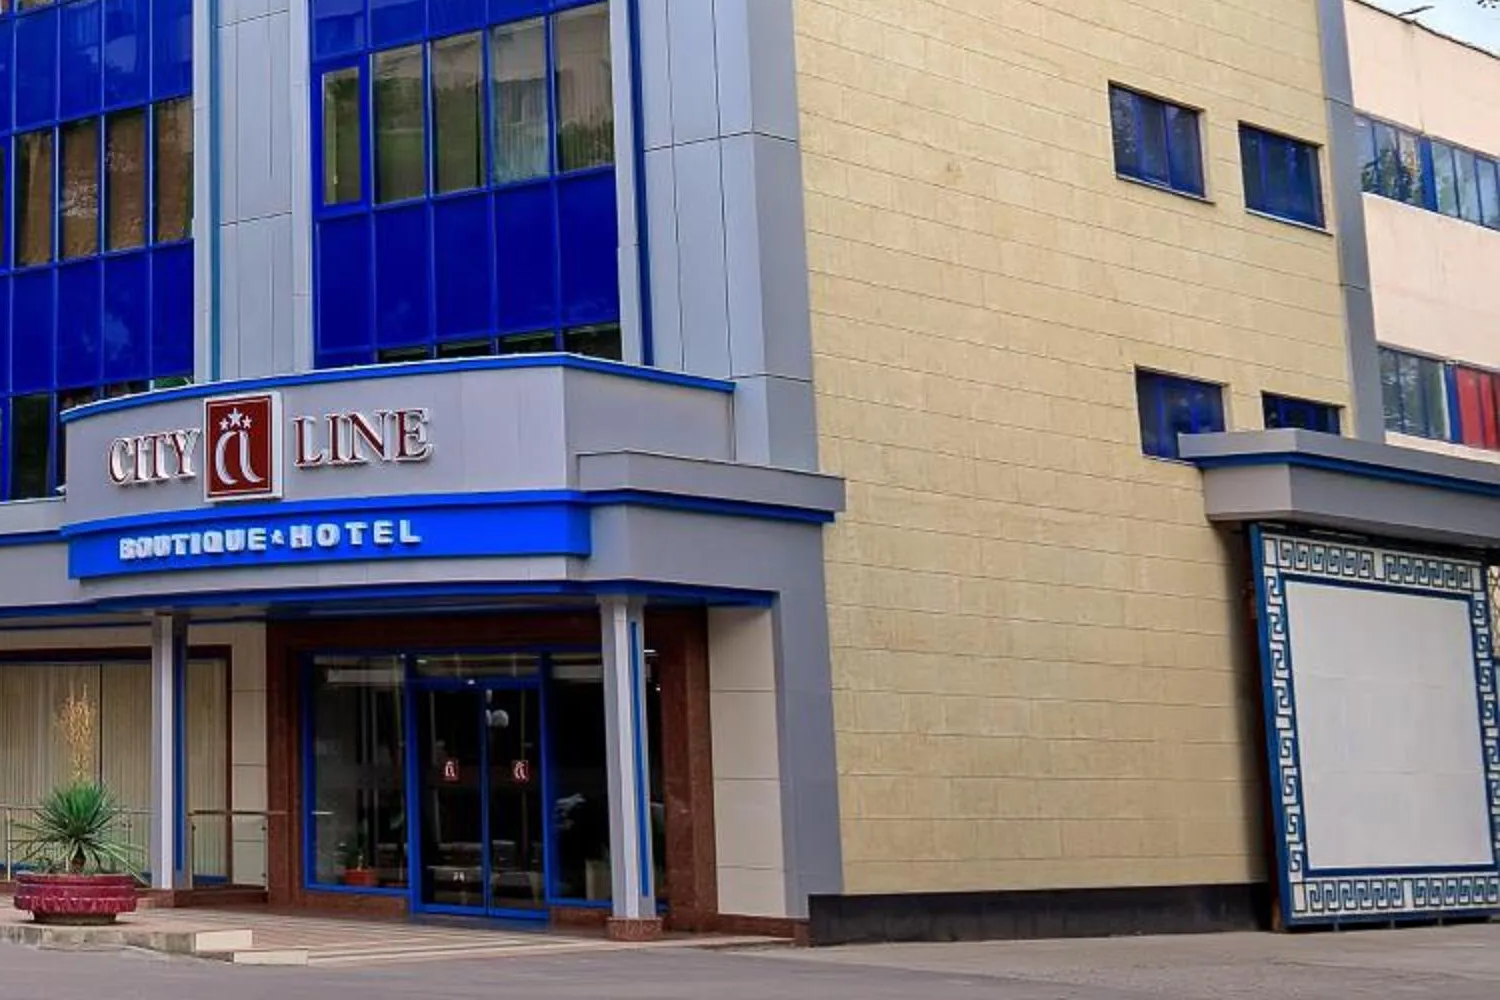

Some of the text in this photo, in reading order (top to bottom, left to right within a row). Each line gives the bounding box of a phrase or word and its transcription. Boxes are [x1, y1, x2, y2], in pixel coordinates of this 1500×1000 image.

[108, 428, 201, 485] CITY
[291, 407, 434, 468] LINE
[119, 519, 423, 560] BOUTIQUE HOTEL
